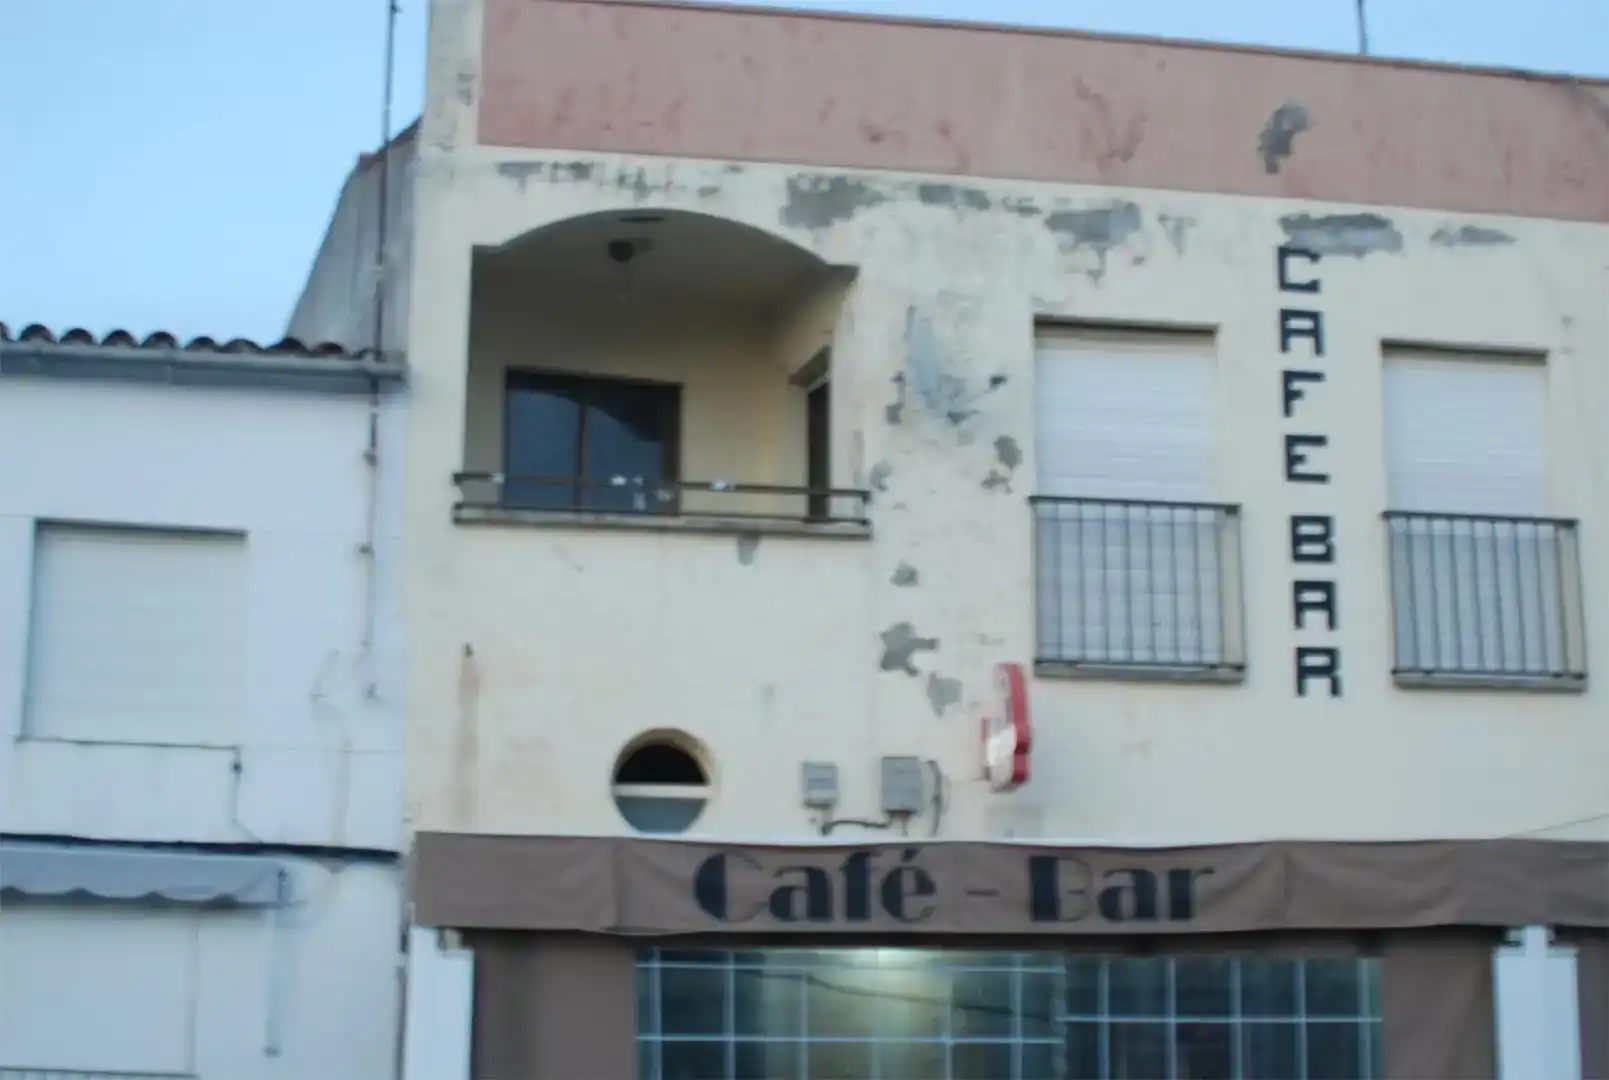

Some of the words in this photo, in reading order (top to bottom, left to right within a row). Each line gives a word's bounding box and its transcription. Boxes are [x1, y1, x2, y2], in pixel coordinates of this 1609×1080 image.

[1277, 246, 1331, 483] CAFE
[1291, 515, 1341, 697] BAR
[692, 848, 937, 923] Café
[1029, 854, 1215, 922] Bar
